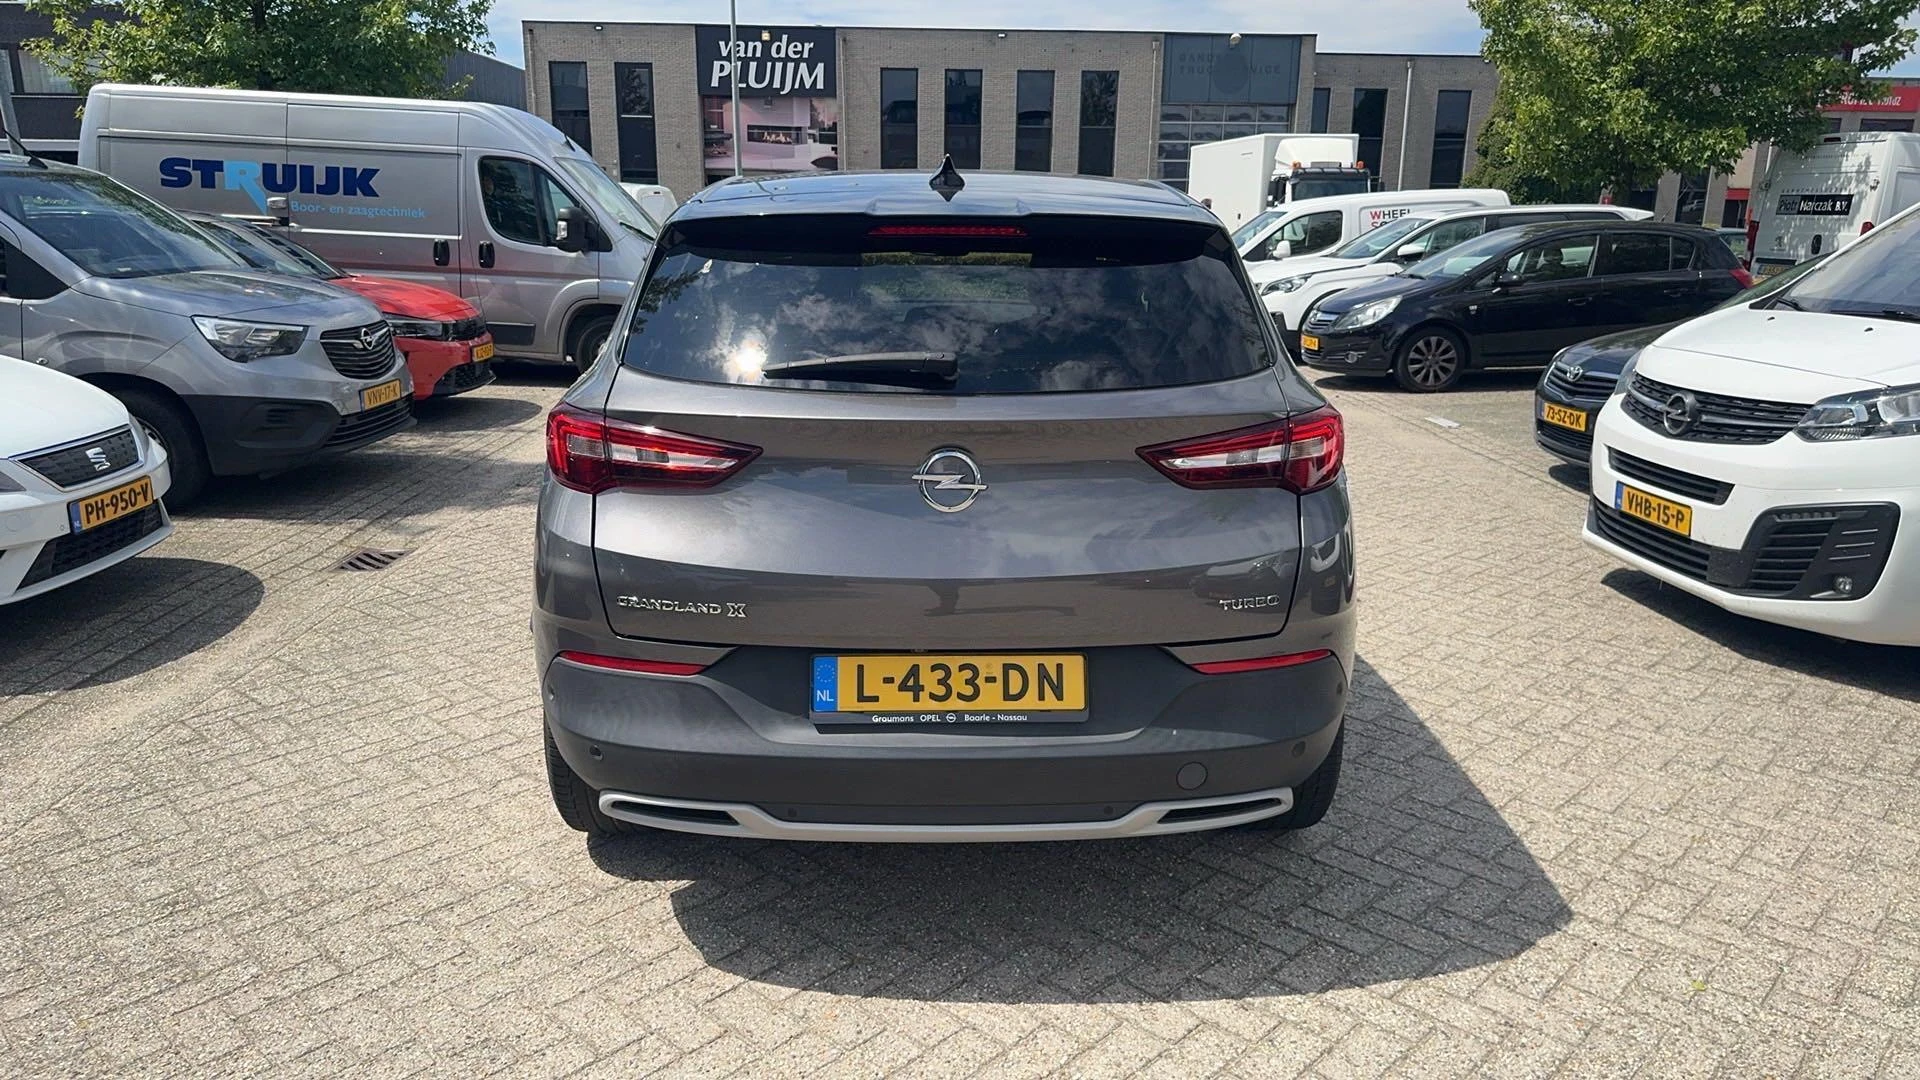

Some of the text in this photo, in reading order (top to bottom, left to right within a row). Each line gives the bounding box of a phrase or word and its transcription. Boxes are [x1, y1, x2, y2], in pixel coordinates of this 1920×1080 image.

[719, 34, 814, 59] van der
[710, 60, 825, 95] PLUIJM
[159, 157, 381, 215] STRUIJK
[291, 200, 425, 219] Boor- en zaagtechniek
[1370, 208, 1410, 220] WHEE
[1546, 405, 1582, 428] 73-SZ-DK
[84, 482, 149, 524] PH-950-V
[1626, 490, 1686, 529] VHB-15-P
[617, 595, 747, 618] GRANDLAND X
[1219, 594, 1280, 611] TURBO
[856, 662, 1064, 703] L-433-DN
[816, 689, 834, 702] NL
[920, 714, 941, 722] OPEL
